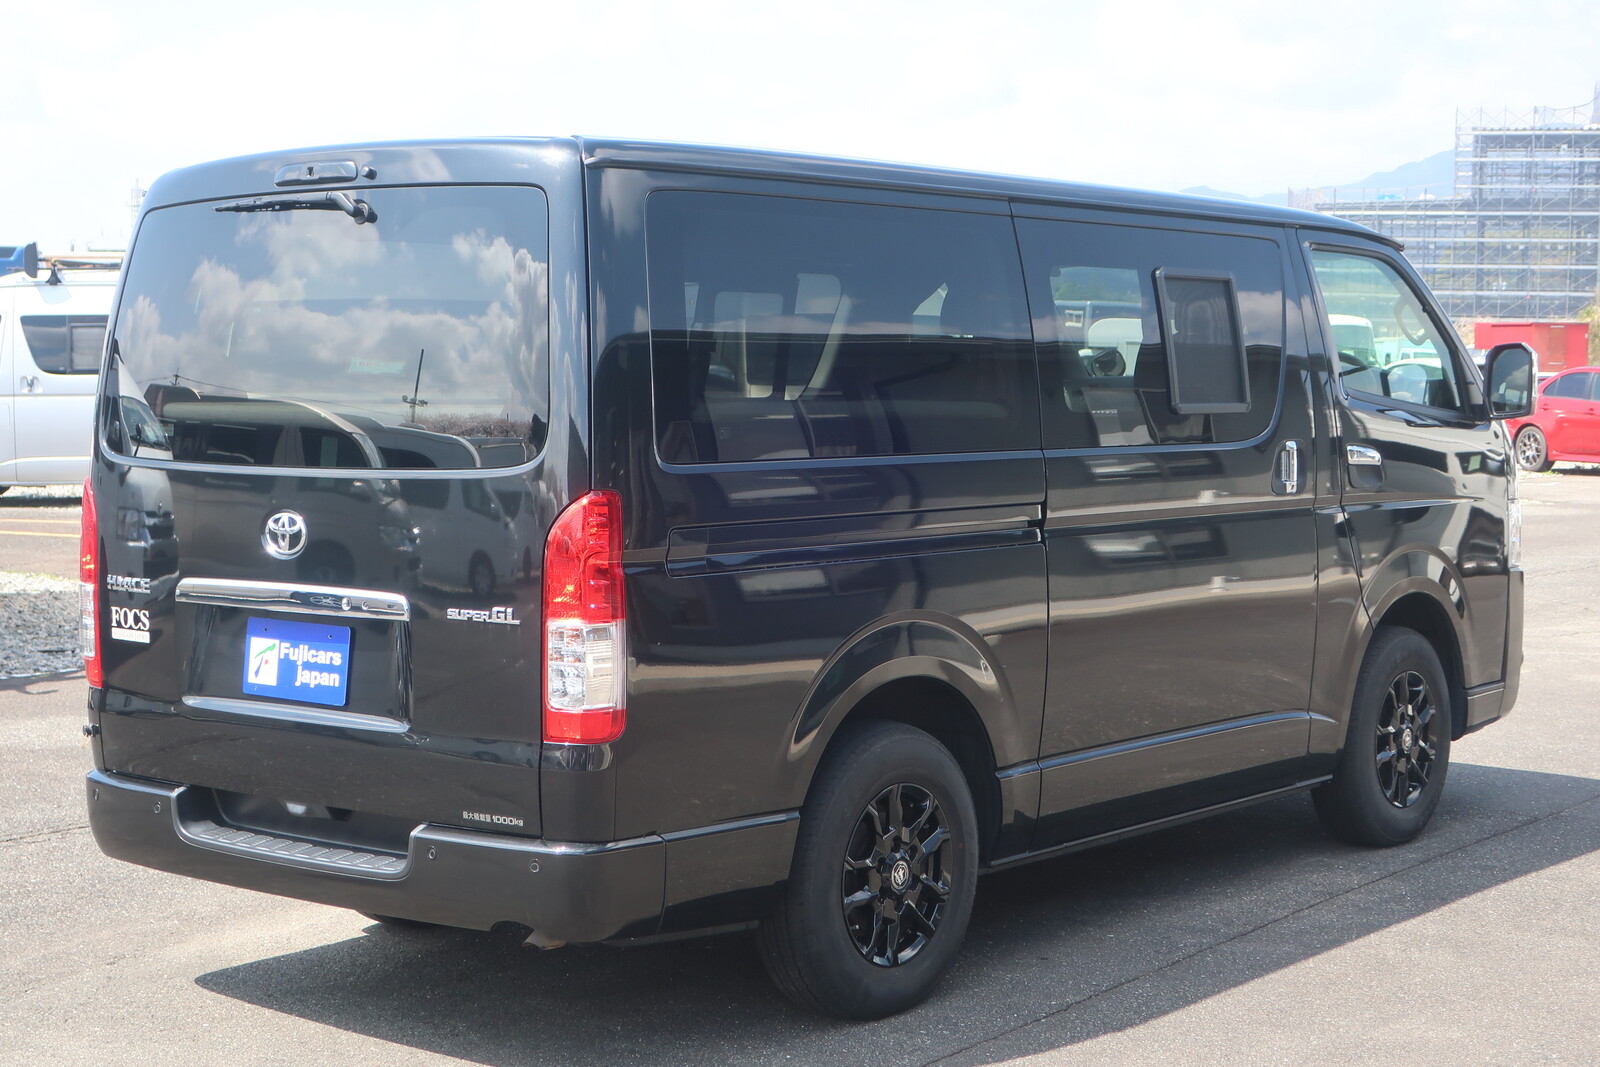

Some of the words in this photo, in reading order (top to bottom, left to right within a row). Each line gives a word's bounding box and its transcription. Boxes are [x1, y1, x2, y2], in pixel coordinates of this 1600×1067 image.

[107, 574, 151, 594] HIACE
[111, 606, 150, 631] FOCS
[279, 642, 342, 666] Fujicars
